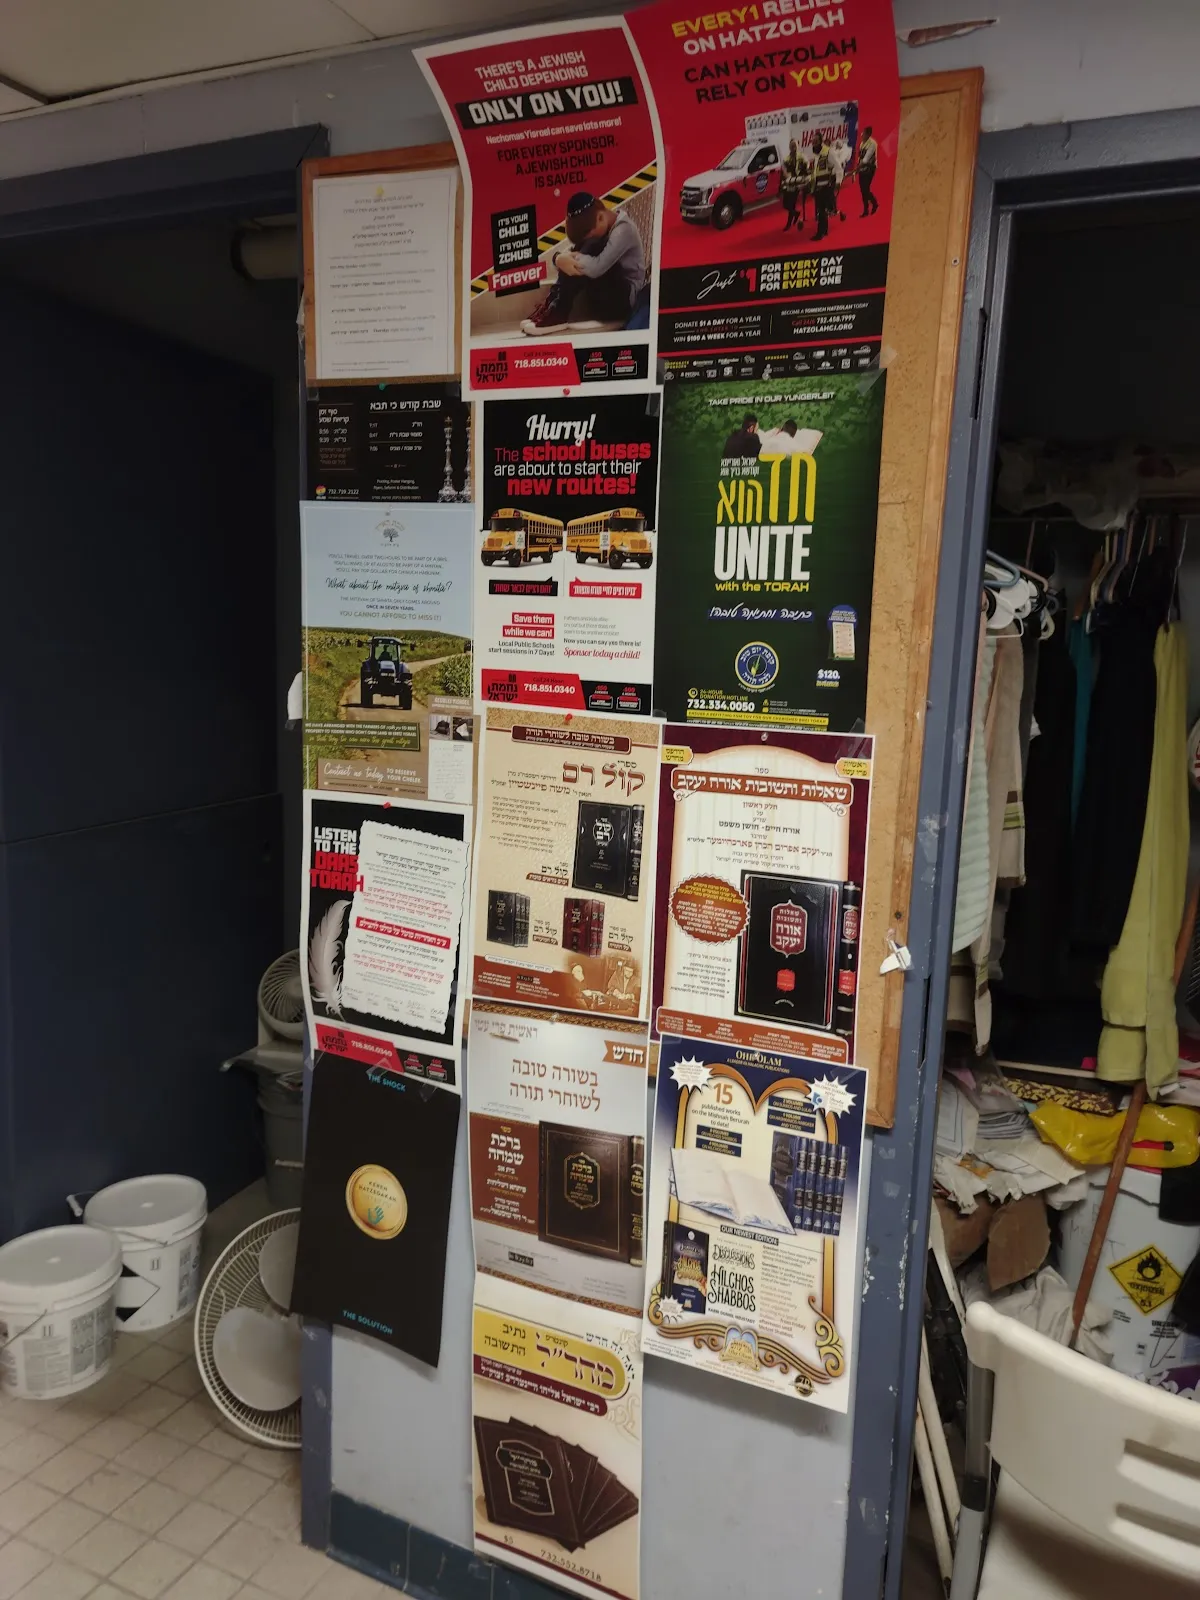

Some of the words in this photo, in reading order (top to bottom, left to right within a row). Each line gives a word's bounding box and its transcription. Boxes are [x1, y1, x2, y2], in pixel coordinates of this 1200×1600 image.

[671, 7, 759, 37] EVERY1
[683, 36, 716, 55] ON
[718, 9, 845, 49] HATZOLAH
[475, 59, 525, 80] THERE'S
[527, 58, 536, 70] A
[539, 50, 586, 68] JEWISH
[684, 61, 730, 84] CAN
[735, 37, 857, 75] HATZOLAH
[483, 76, 519, 93] CHILD
[521, 65, 589, 87] DEPENDING
[695, 79, 748, 104] RELY
[754, 74, 786, 93] ON
[789, 61, 853, 87] YOU?
[468, 96, 524, 125] ONLY
[530, 90, 565, 115] ON
[566, 81, 624, 110] YOU!
[515, 164, 524, 176] A
[525, 158, 569, 175] JEWISH
[569, 153, 604, 171] CHILD
[534, 176, 544, 189] IS
[511, 214, 528, 224] YOUR
[499, 224, 529, 238] CHILD!
[511, 239, 529, 250] YOUR
[499, 248, 532, 264] ZCHUS!
[761, 263, 781, 273] FOR
[783, 258, 819, 271] EVERY
[821, 256, 843, 267] DAY
[492, 266, 542, 288] Forever
[760, 272, 780, 282] FOR
[783, 268, 817, 280] EVERY
[820, 266, 843, 276] LIFE
[760, 282, 780, 292] FOR
[782, 278, 816, 290] EVERY
[820, 276, 841, 286] ONE
[675, 321, 699, 329] DONATE
[712, 318, 725, 326] DAY
[745, 315, 761, 323] YEAR
[514, 358, 568, 368] 718.851.0340
[370, 402, 387, 410] תבא
[400, 401, 419, 411] קודש
[423, 400, 441, 409] שבת
[730, 397, 753, 405] PRIDE
[784, 391, 835, 401] YUNGERLEIT
[526, 414, 596, 446] Hurry!
[495, 448, 519, 462] The
[522, 441, 585, 461] school
[590, 440, 651, 459] buses
[494, 464, 515, 476] are
[518, 462, 555, 476] about
[558, 462, 572, 475] to
[575, 462, 608, 475] start
[610, 459, 642, 474] their
[508, 478, 552, 495] new
[557, 473, 636, 495] routes!
[758, 452, 817, 523] חד
[716, 479, 763, 525] הוא
[714, 525, 813, 581] UNITE
[715, 582, 739, 592] with
[742, 582, 760, 591] the
[764, 582, 809, 592] TORAH
[514, 614, 532, 624] Save
[533, 615, 552, 624] them
[505, 627, 525, 637] while
[525, 629, 536, 637] we
[537, 629, 552, 637] can!
[564, 647, 592, 659] Sponsor
[592, 648, 614, 660] today
[619, 649, 640, 660] child!
[524, 684, 575, 694] 718.851.0340
[687, 699, 755, 712] 732.334.0050
[324, 762, 352, 776] Contact
[562, 761, 595, 786] רם
[602, 763, 646, 797] קול
[677, 774, 707, 791] יעקב
[709, 775, 742, 791] אורח
[744, 779, 798, 795] ותשובות
[801, 780, 848, 800] שאלות
[743, 802, 763, 810] ראשון
[764, 803, 778, 811] חלק
[314, 826, 357, 842] LISTEN
[314, 839, 331, 853] TO
[333, 840, 357, 855] THE
[314, 850, 359, 873] DAAS
[309, 869, 364, 892] TORAH
[776, 914, 802, 923] ותשובות
[775, 924, 802, 935] אורח
[775, 935, 800, 949] יעקב
[612, 1045, 644, 1064] חדש
[512, 1058, 547, 1077] טובה
[552, 1065, 599, 1087] בשורה
[368, 1073, 381, 1085] THE
[383, 1077, 406, 1092] SHOCK
[510, 1082, 544, 1102] תורה
[548, 1089, 601, 1112] לשוחרי
[713, 1083, 733, 1105] 15
[701, 1103, 726, 1114] published
[726, 1107, 741, 1116] works
[708, 1110, 727, 1121] Mishnah
[727, 1115, 750, 1125] Berurah
[717, 1121, 730, 1129] date!
[490, 1132, 521, 1151] ברכת
[488, 1147, 524, 1166] שמחה
[722, 1226, 733, 1234] OUR
[734, 1228, 755, 1241] NEWEST
[712, 1244, 755, 1270] DISCUSSIONS
[711, 1263, 754, 1294] HILCHOS
[707, 1280, 756, 1312] SHABBOS
[342, 1310, 356, 1320] THE
[358, 1315, 393, 1335] SOLUTION
[502, 1323, 526, 1339] נתיב
[484, 1334, 526, 1357] התשובה
